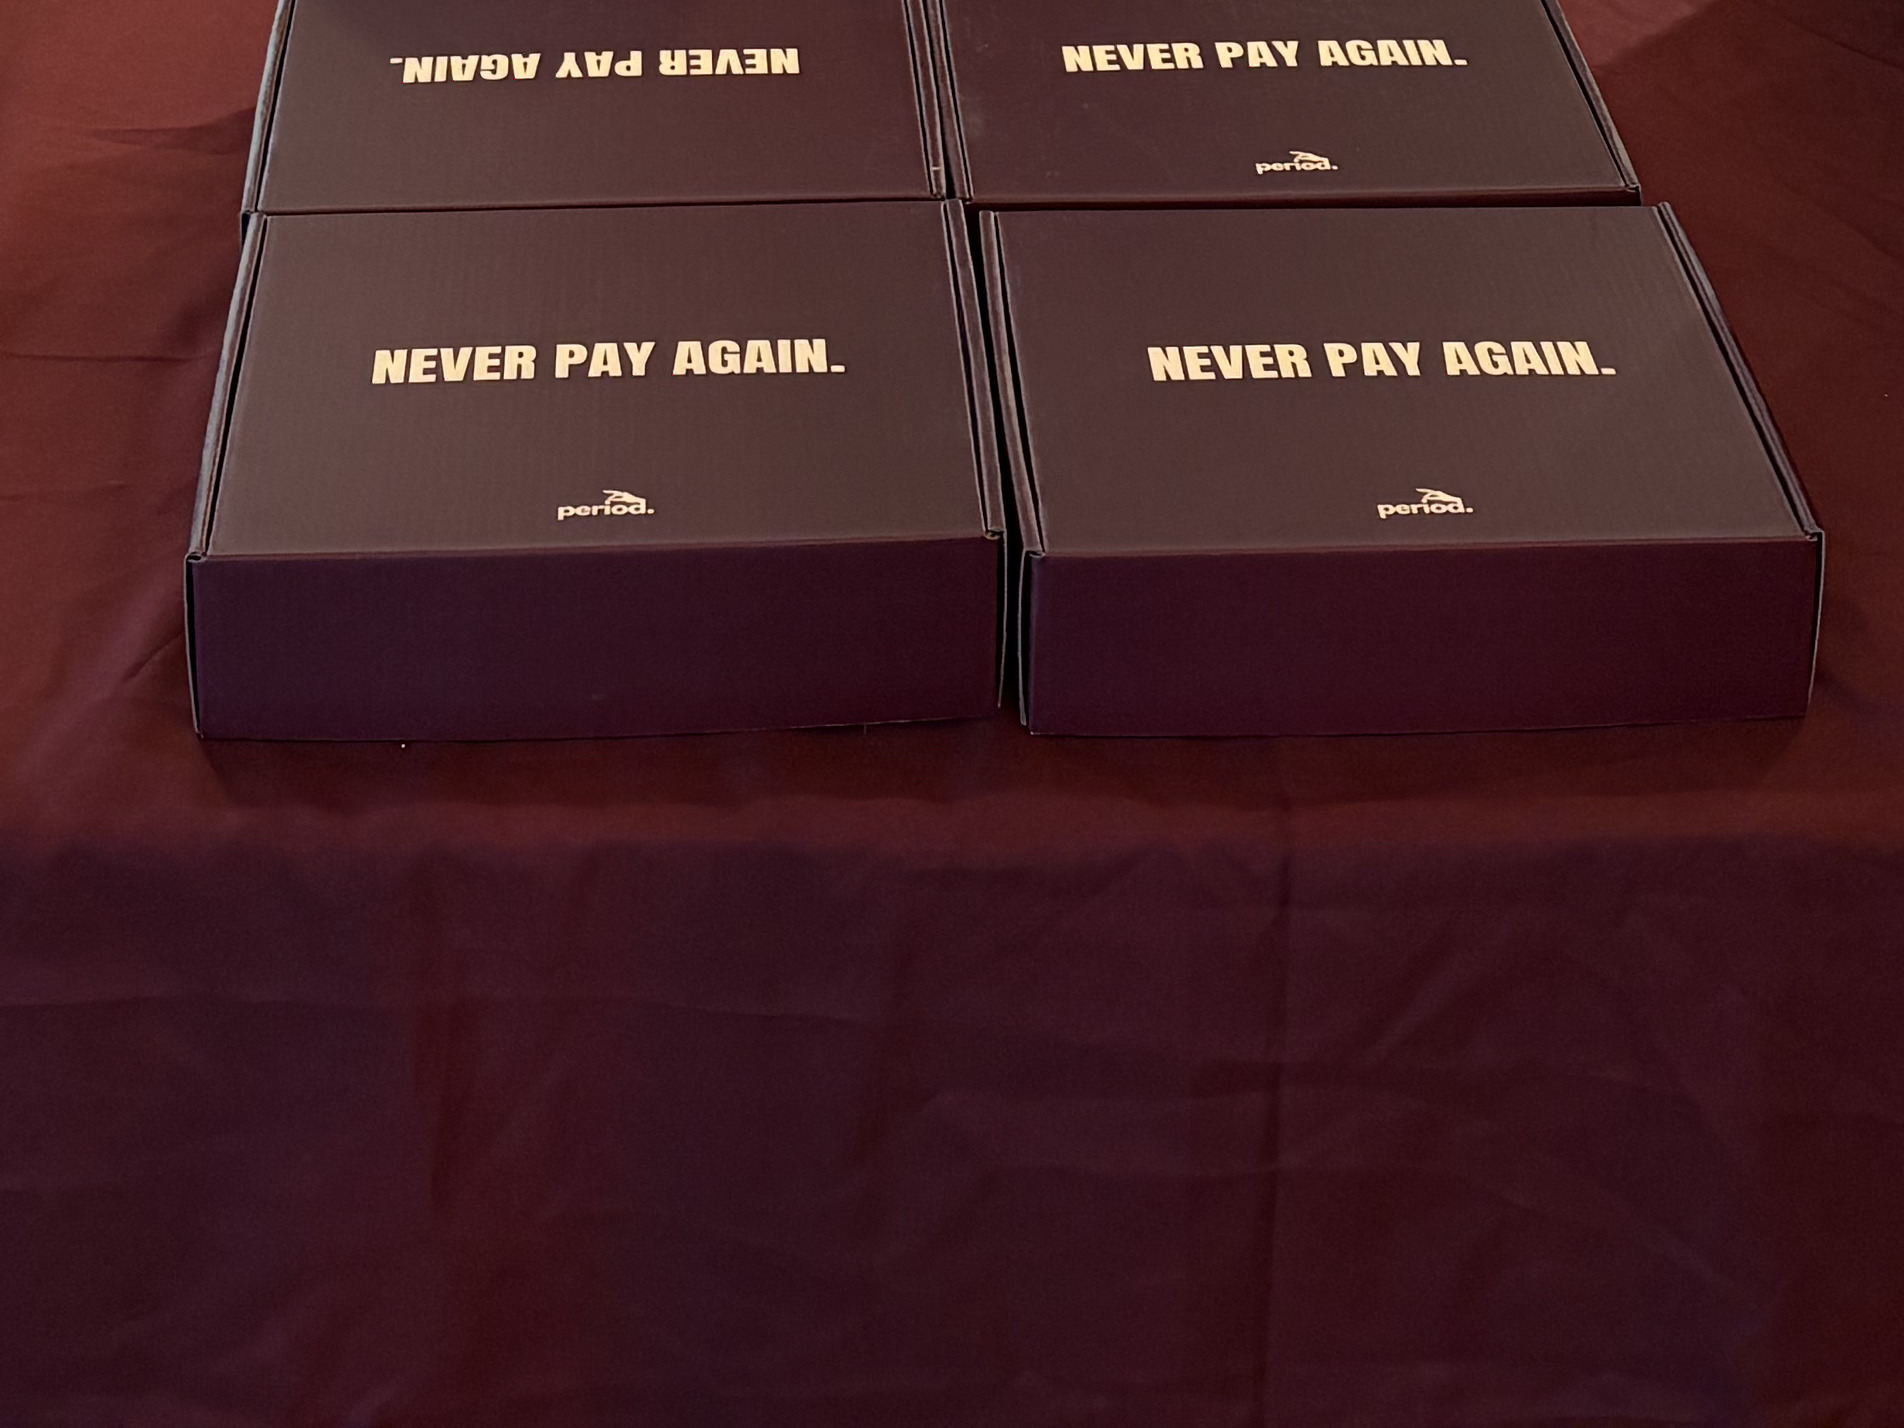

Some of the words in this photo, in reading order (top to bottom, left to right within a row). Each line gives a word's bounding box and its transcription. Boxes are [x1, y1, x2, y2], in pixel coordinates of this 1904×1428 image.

[389, 53, 541, 85] AGAIN.
[555, 50, 643, 79] PAY
[658, 48, 800, 76] NEVER
[1061, 42, 1204, 73] NEVER
[1214, 40, 1299, 69] PAY
[1317, 39, 1468, 67] AGAIN.
[1255, 157, 1338, 175] period.
[371, 345, 537, 385] NEVER
[554, 341, 656, 379] PAY
[672, 338, 846, 376] AGAIN.
[1147, 343, 1312, 382] NEVER
[1323, 341, 1421, 377] PAY
[1442, 341, 1617, 376] AGAIN.
[557, 498, 655, 521] period.
[1377, 497, 1474, 519] period.
